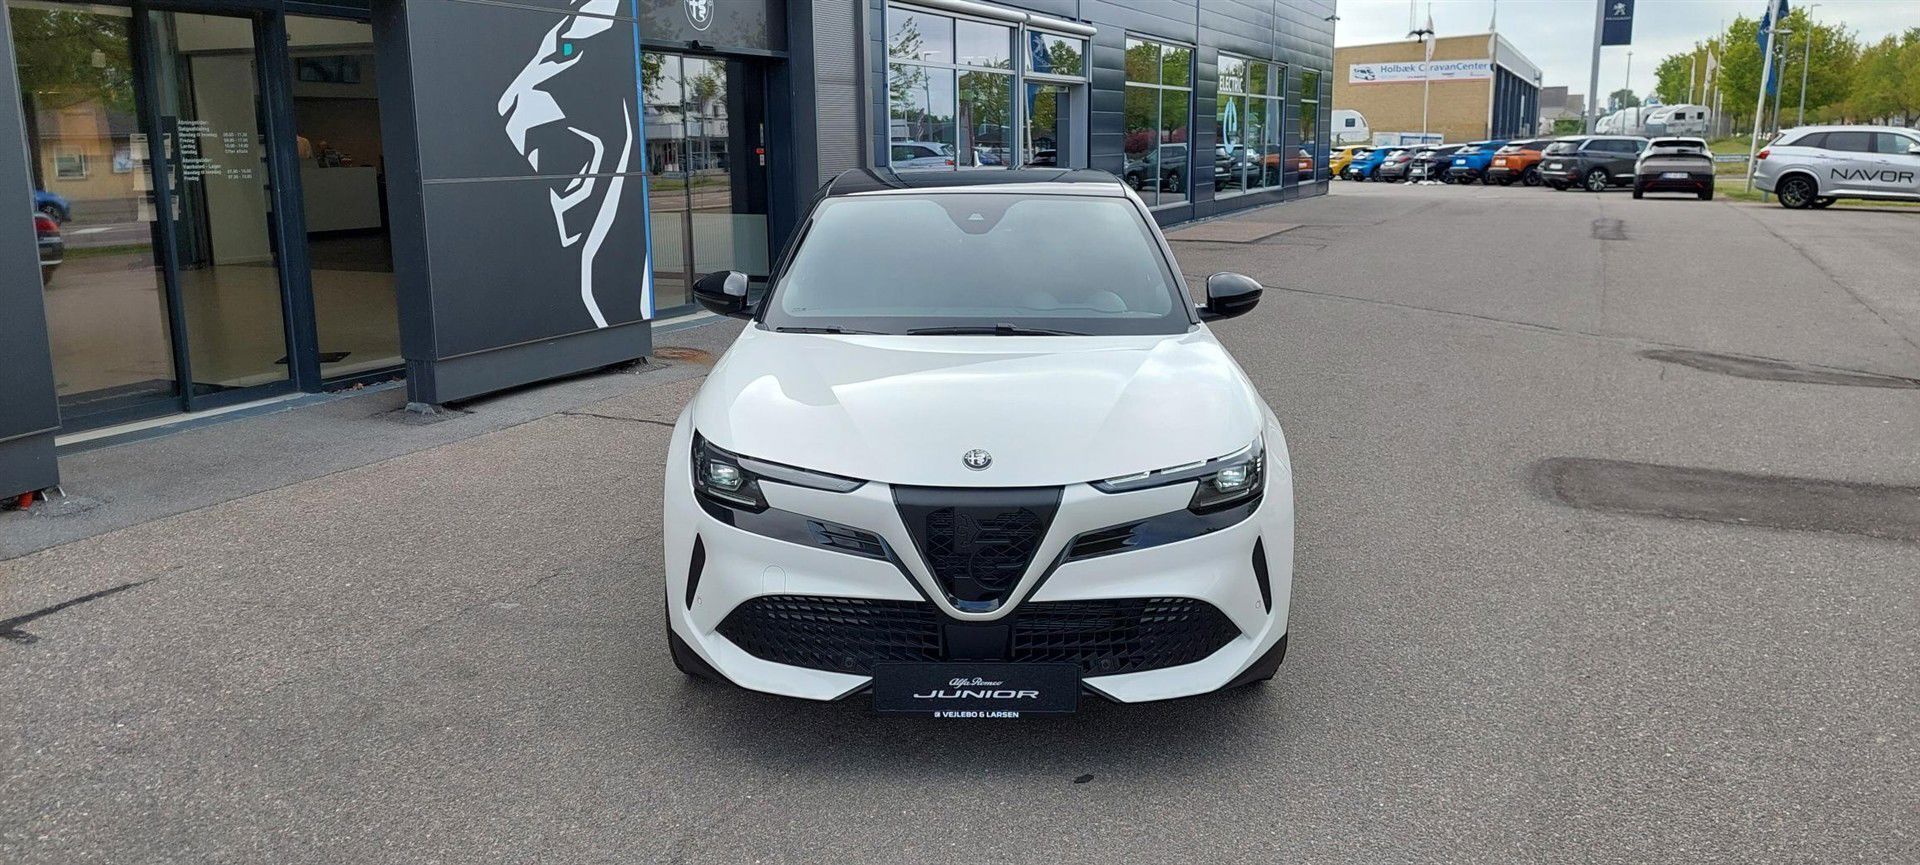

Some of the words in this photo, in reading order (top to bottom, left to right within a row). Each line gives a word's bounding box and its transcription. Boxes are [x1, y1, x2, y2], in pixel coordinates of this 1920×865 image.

[1380, 64, 1415, 73] Holbæk
[1418, 62, 1488, 72] CravanCenter
[1219, 75, 1243, 93] ELECTRIC
[1830, 168, 1914, 184] NAVOR
[949, 677, 971, 689] Alfa
[971, 677, 1004, 687] Romeo
[913, 690, 1040, 699] JUNIOR
